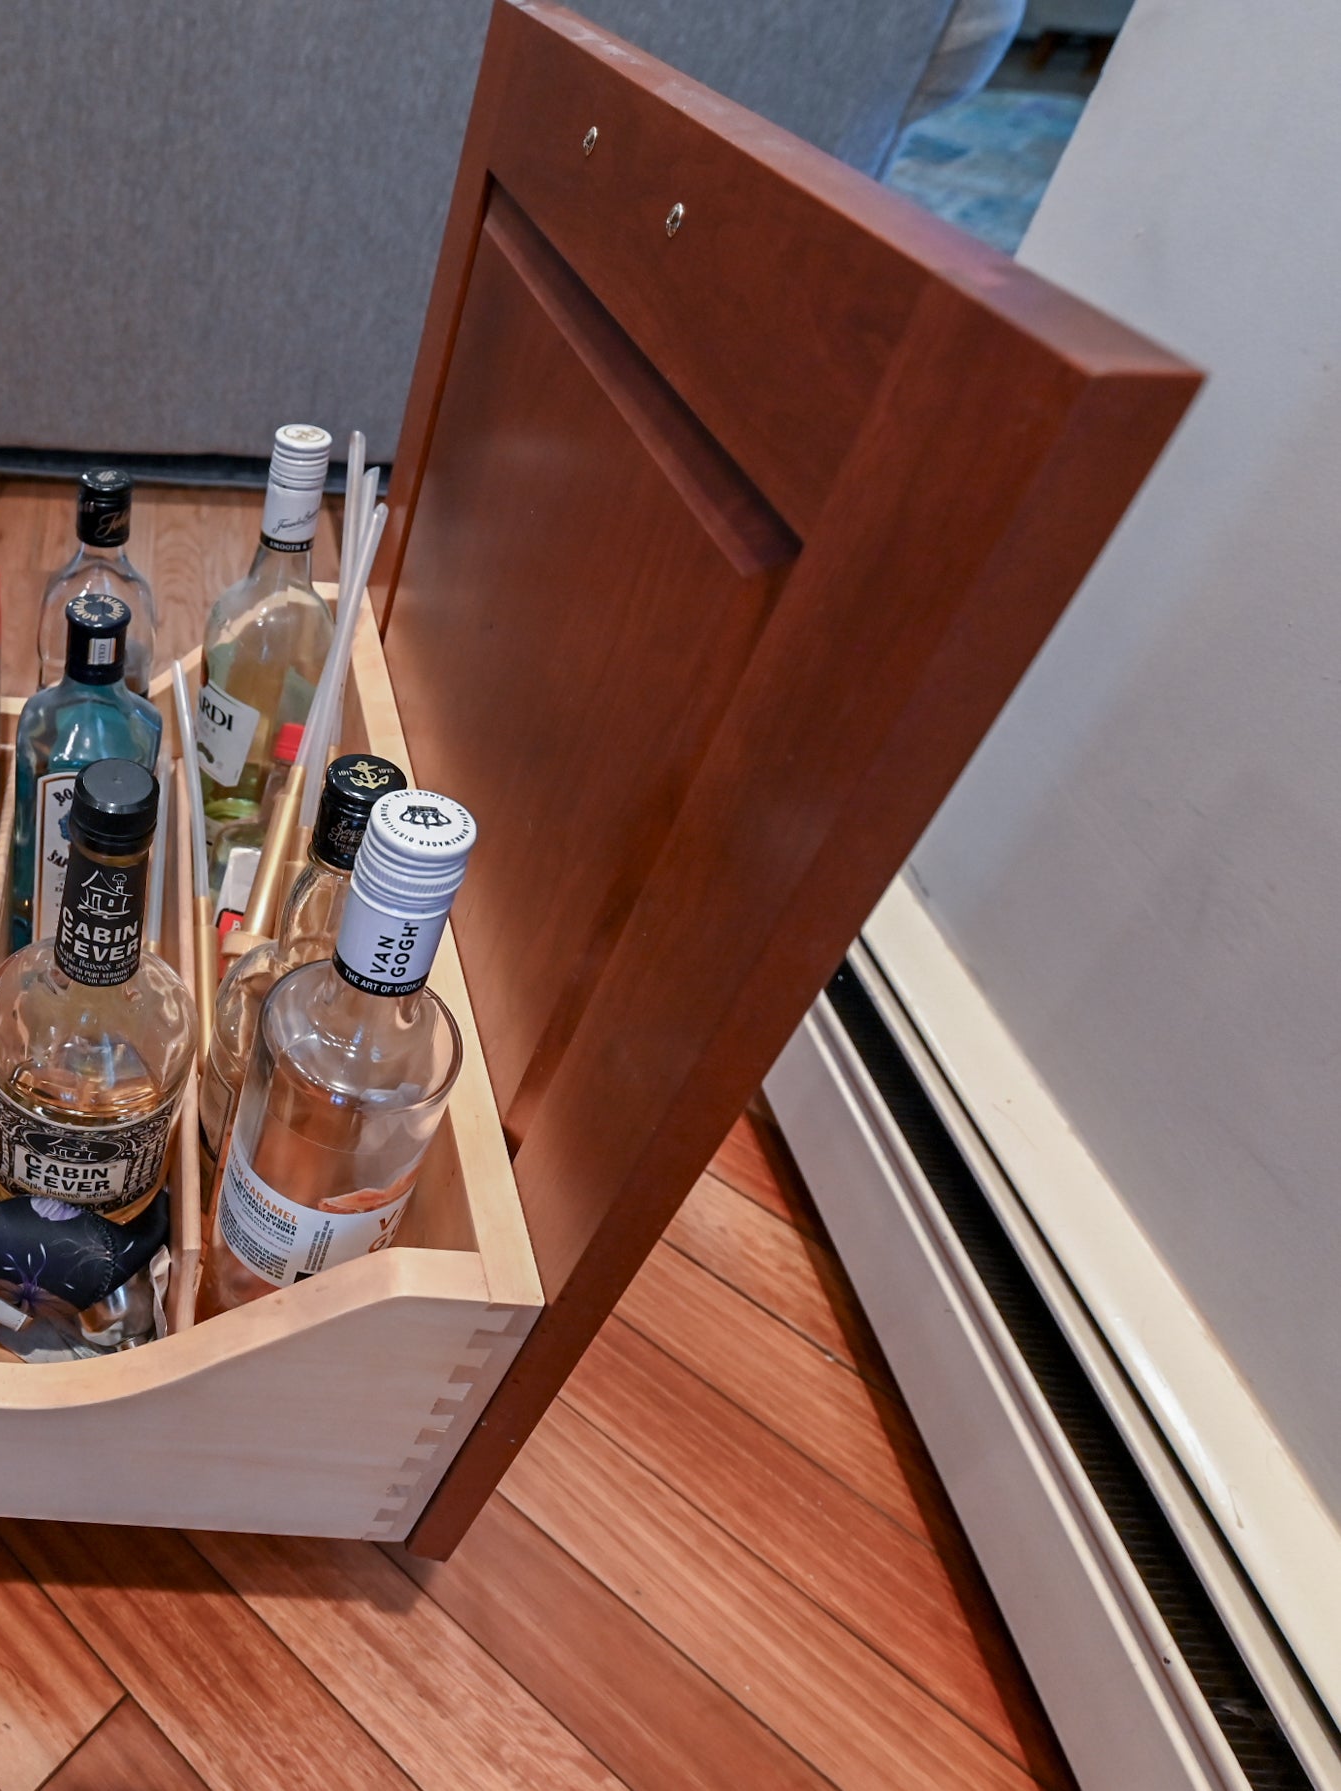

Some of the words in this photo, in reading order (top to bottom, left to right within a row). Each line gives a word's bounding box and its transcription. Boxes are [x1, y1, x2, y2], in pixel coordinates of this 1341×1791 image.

[62, 906, 138, 944] CABIN
[61, 925, 139, 962] FEVER
[369, 935, 395, 973] VAN
[390, 926, 419, 977] GOGH
[344, 968, 359, 983] THE
[360, 979, 380, 991] ART
[380, 984, 393, 993] OF
[394, 980, 422, 993] VODKA
[24, 1153, 108, 1179] CABIN
[26, 1166, 110, 1192] FEVER
[244, 1177, 298, 1225] CARAMEL
[266, 1210, 297, 1232] INFUSED
[271, 1218, 296, 1237] VODKA
